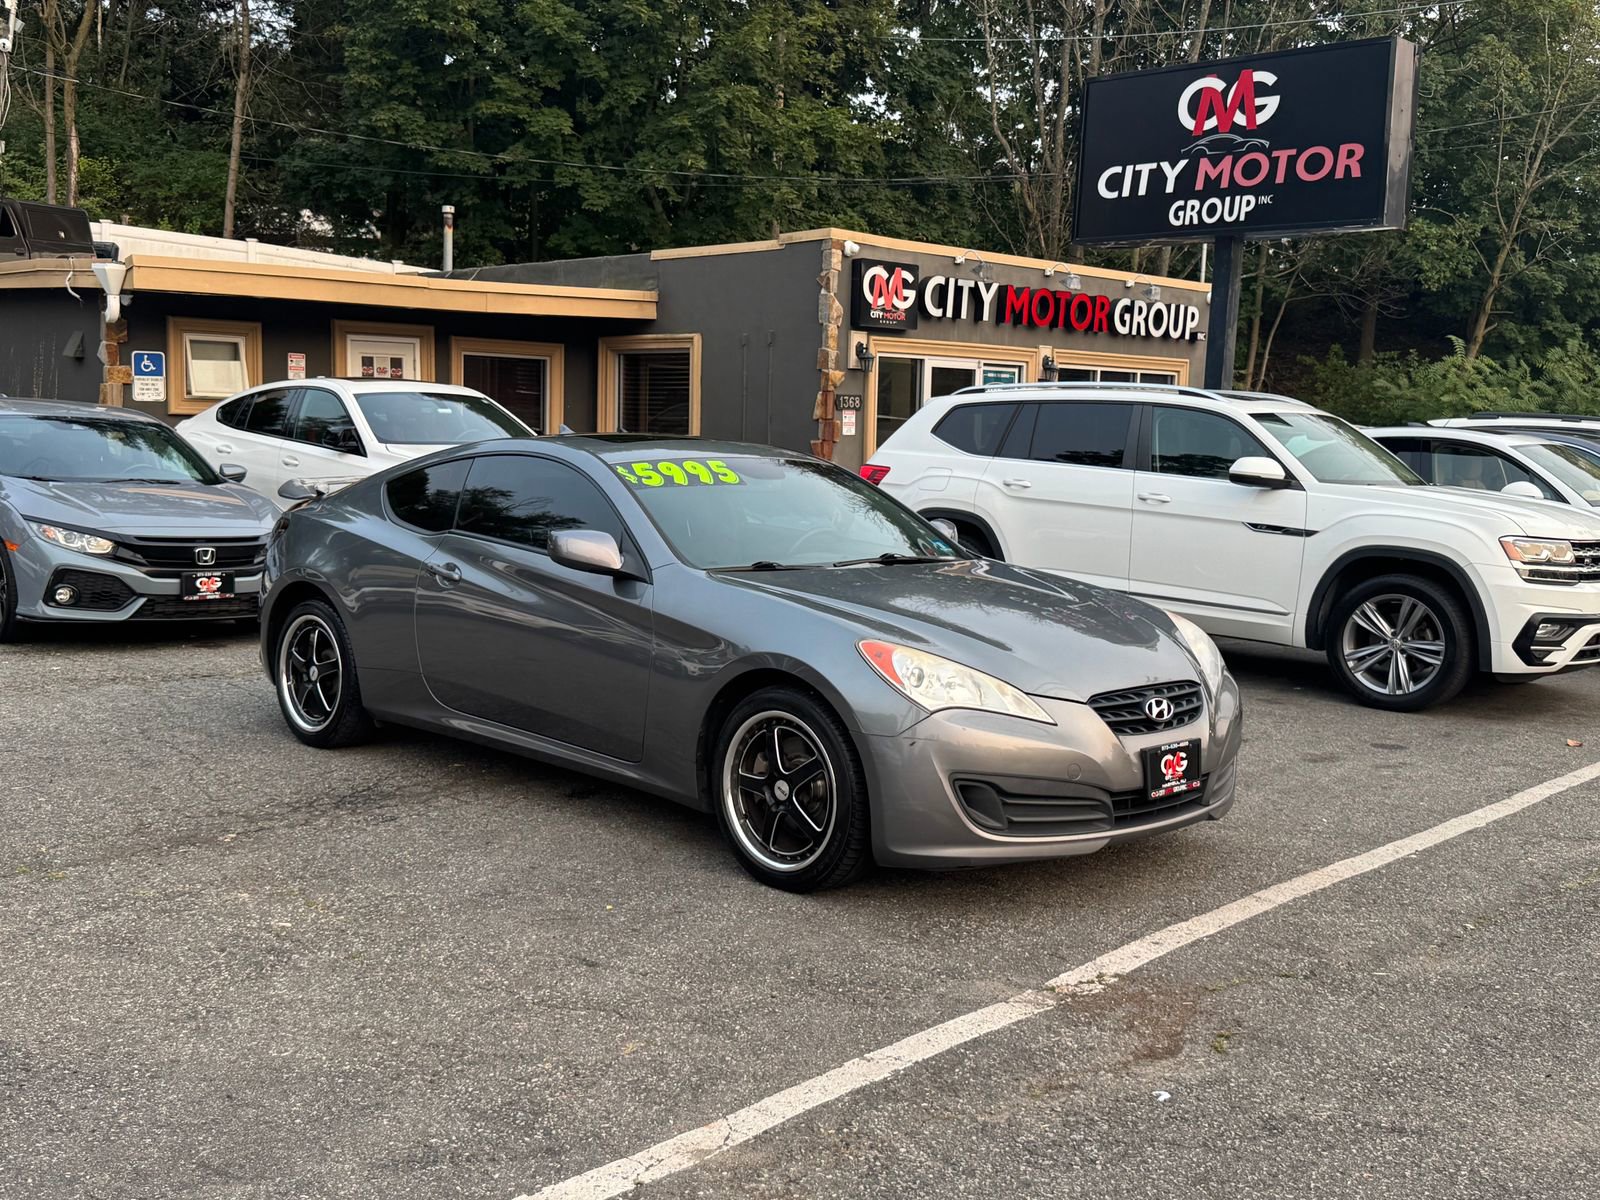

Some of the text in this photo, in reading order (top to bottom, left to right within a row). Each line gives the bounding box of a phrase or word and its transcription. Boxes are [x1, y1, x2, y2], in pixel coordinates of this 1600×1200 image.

[1098, 143, 1365, 199] CITY MOTOR
[1168, 194, 1274, 226] GROUP INC
[924, 275, 999, 321] CITY
[1005, 284, 1110, 333] MOTOR
[1113, 297, 1200, 341] GROUP
[840, 396, 860, 408] 1368
[616, 459, 740, 487] $5995
